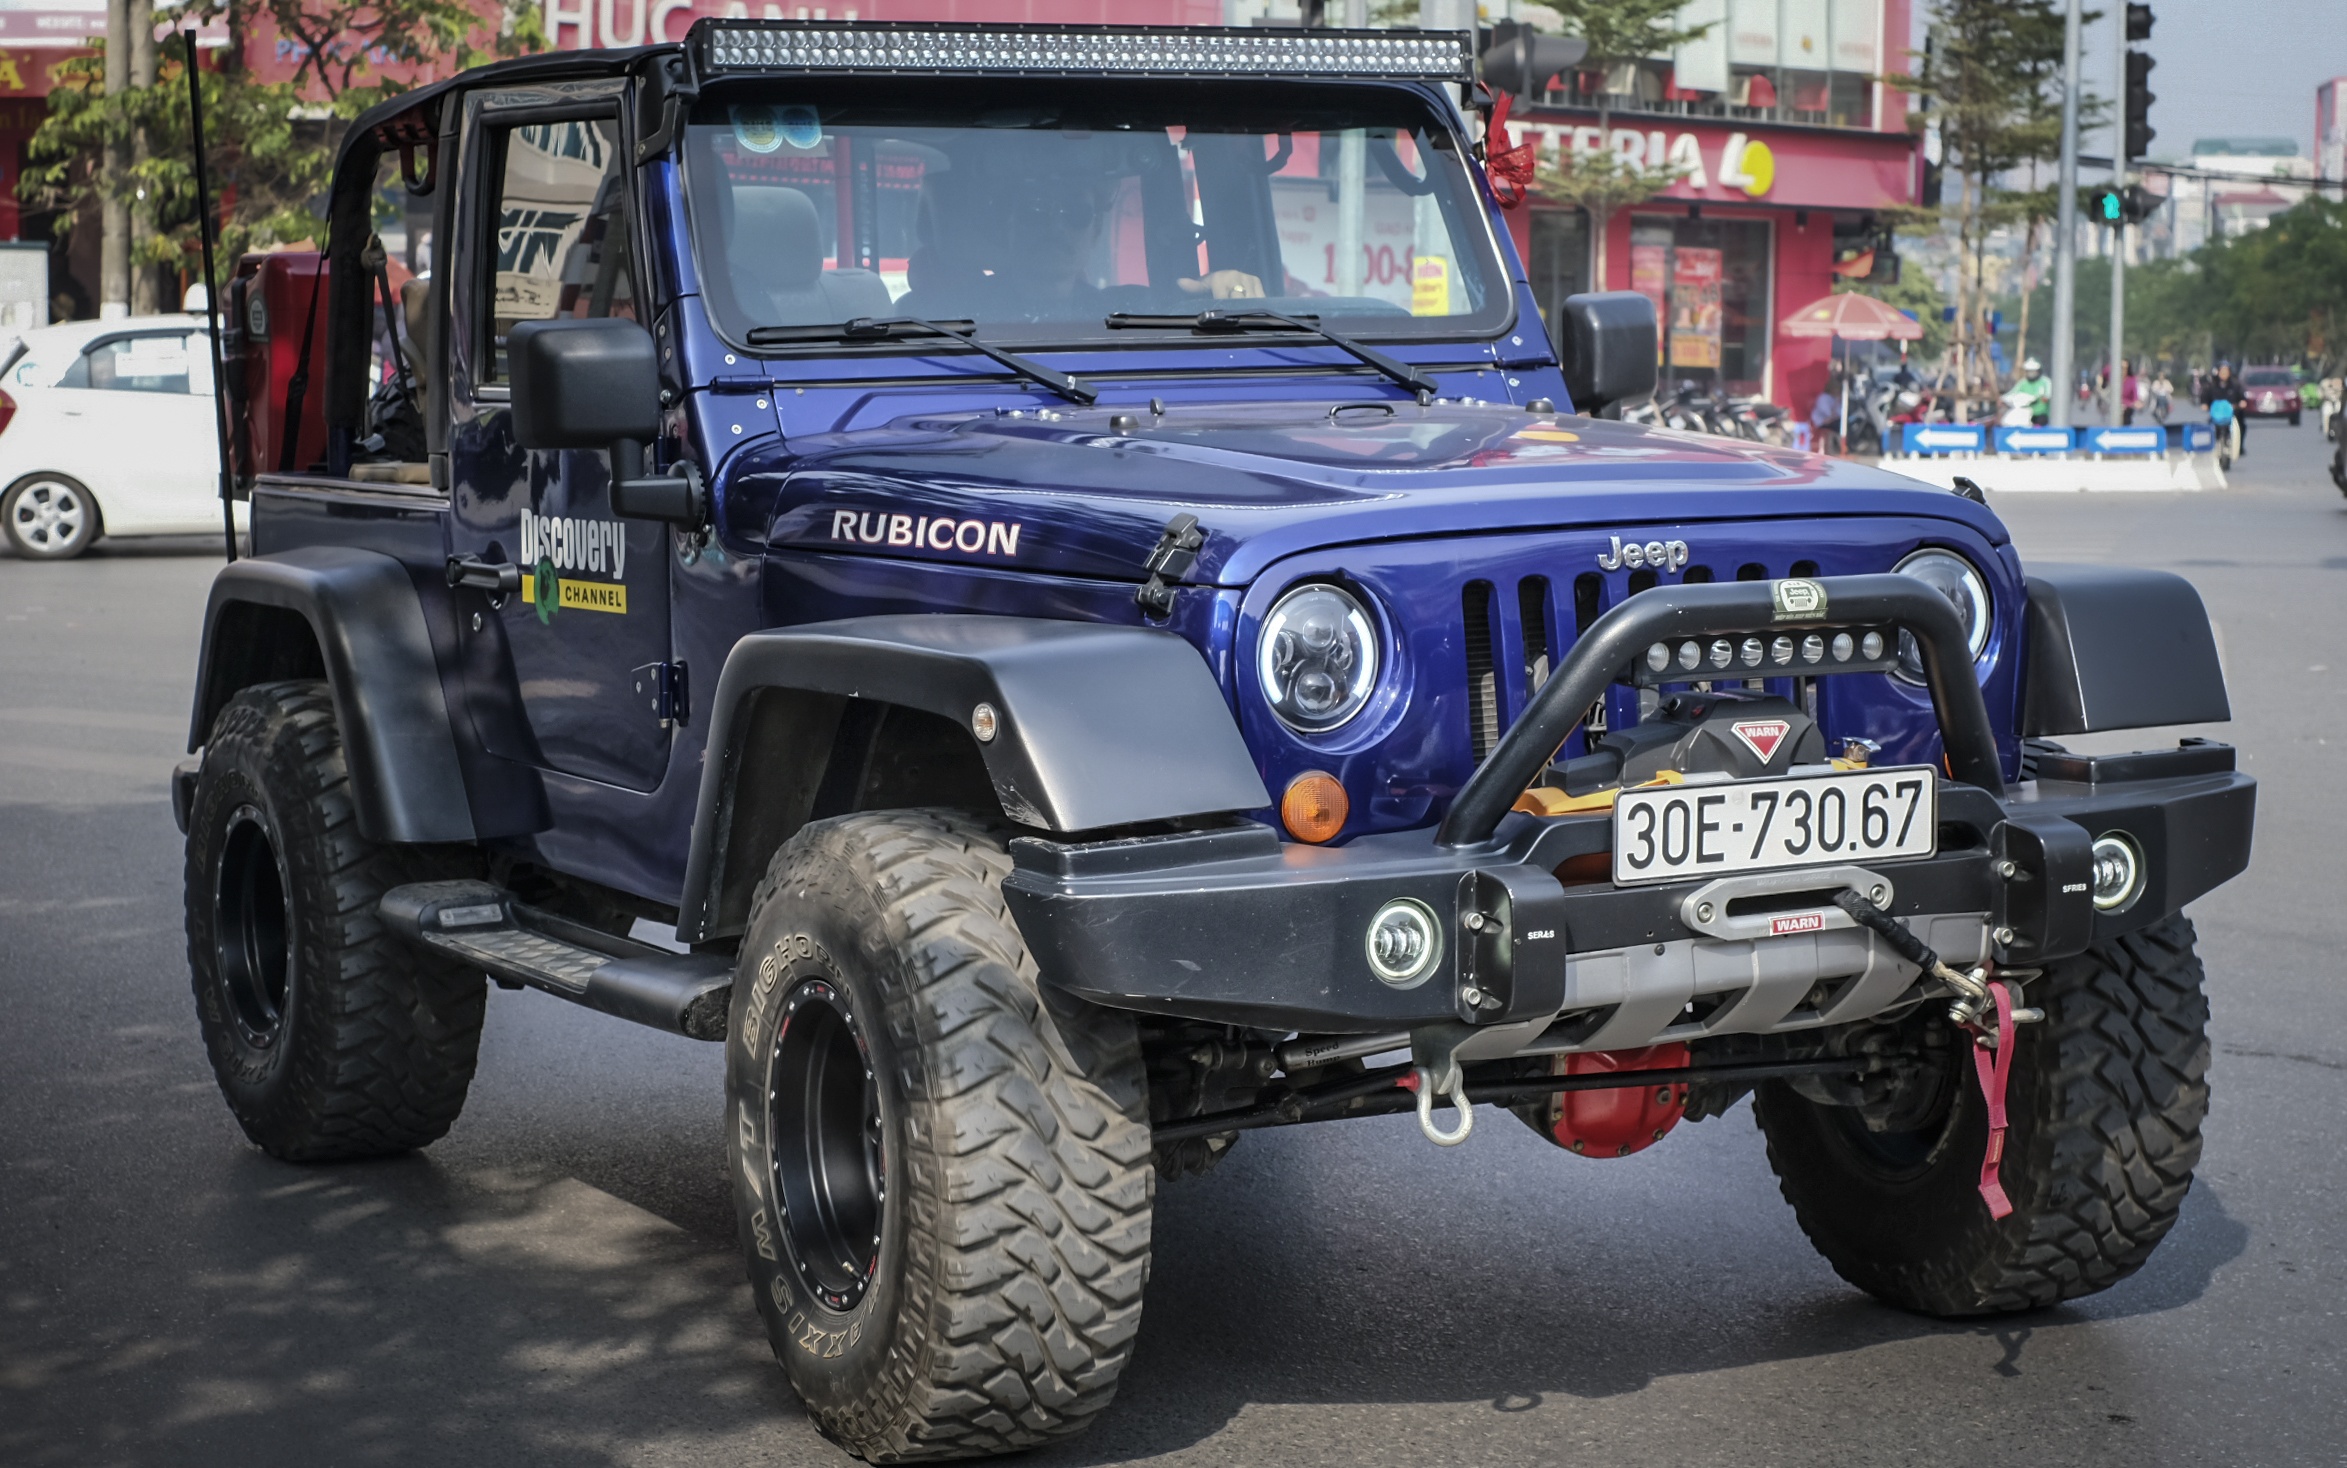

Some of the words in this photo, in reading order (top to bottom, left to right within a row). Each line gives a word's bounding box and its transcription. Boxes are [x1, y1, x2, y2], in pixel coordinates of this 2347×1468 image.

[502, 0, 698, 48] HUC
[1503, 120, 1709, 189] TTERIA
[831, 509, 1022, 557] RUBICON
[1597, 536, 1689, 573] Jeep
[565, 585, 622, 608] CHANNEL
[1745, 726, 1780, 738] WARN
[1627, 779, 1923, 870] 30E-730.67
[1776, 916, 1819, 932] WARN
[1305, 1041, 1340, 1057] Speed
